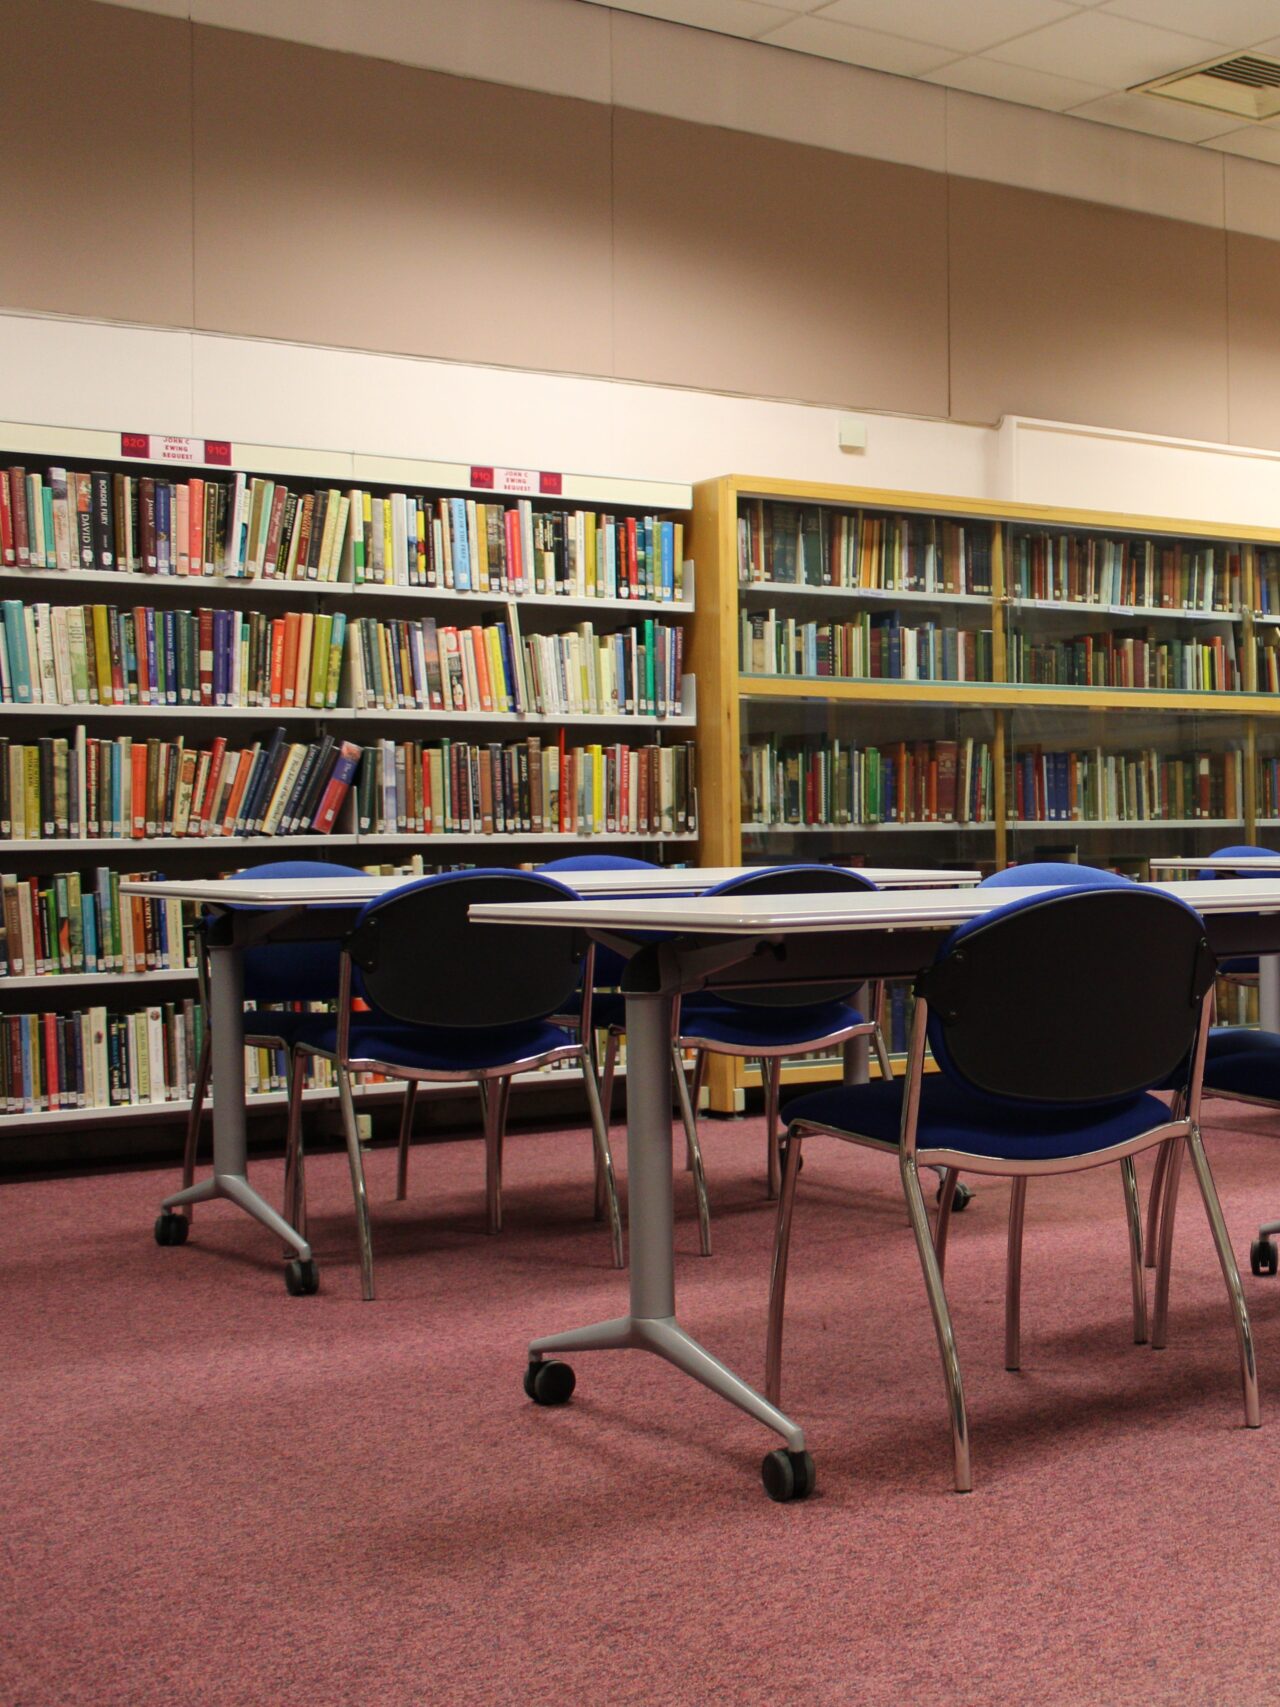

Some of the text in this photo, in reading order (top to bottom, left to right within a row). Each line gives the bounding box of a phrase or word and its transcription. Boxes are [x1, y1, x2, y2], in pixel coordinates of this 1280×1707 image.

[123, 436, 145, 449] 820
[163, 437, 183, 445] JOHN
[208, 445, 228, 456] 910
[163, 452, 193, 460] BEQUEST
[473, 472, 491, 482] 910
[504, 484, 531, 492] BEQUEST
[99, 480, 108, 525] BORDER FURY
[81, 514, 90, 543] DAVID
